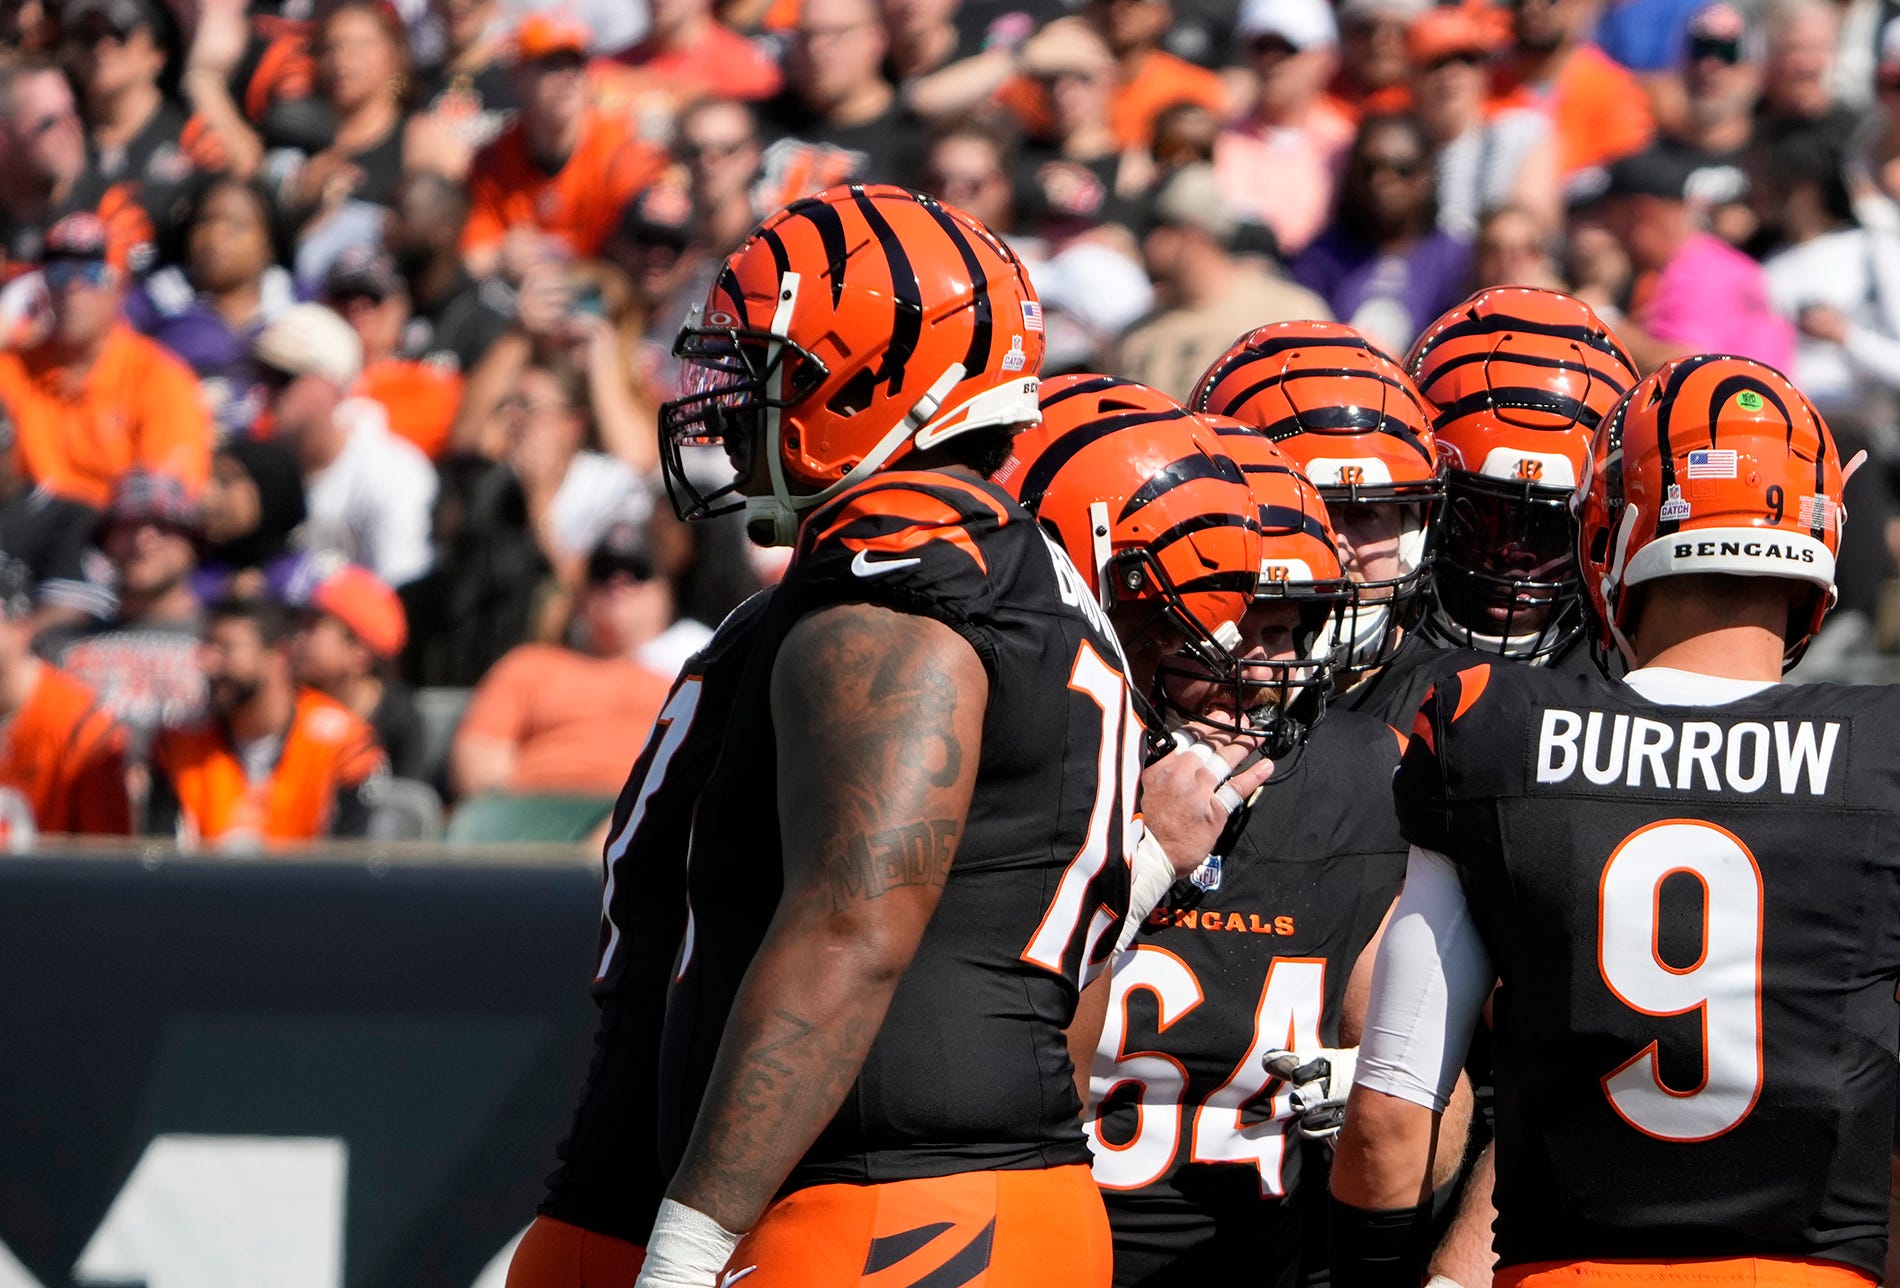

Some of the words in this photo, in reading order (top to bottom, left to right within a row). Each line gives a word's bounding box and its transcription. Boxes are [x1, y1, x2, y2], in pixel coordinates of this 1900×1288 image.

[1661, 504, 1690, 516] CATCH
[1765, 484, 1784, 526] 9
[1673, 542, 1814, 564] BENGALS
[1536, 708, 1841, 796] BURROW
[1149, 906, 1296, 937] ENGALS
[1597, 817, 1764, 1143] 9
[1084, 943, 1328, 1201] 64
